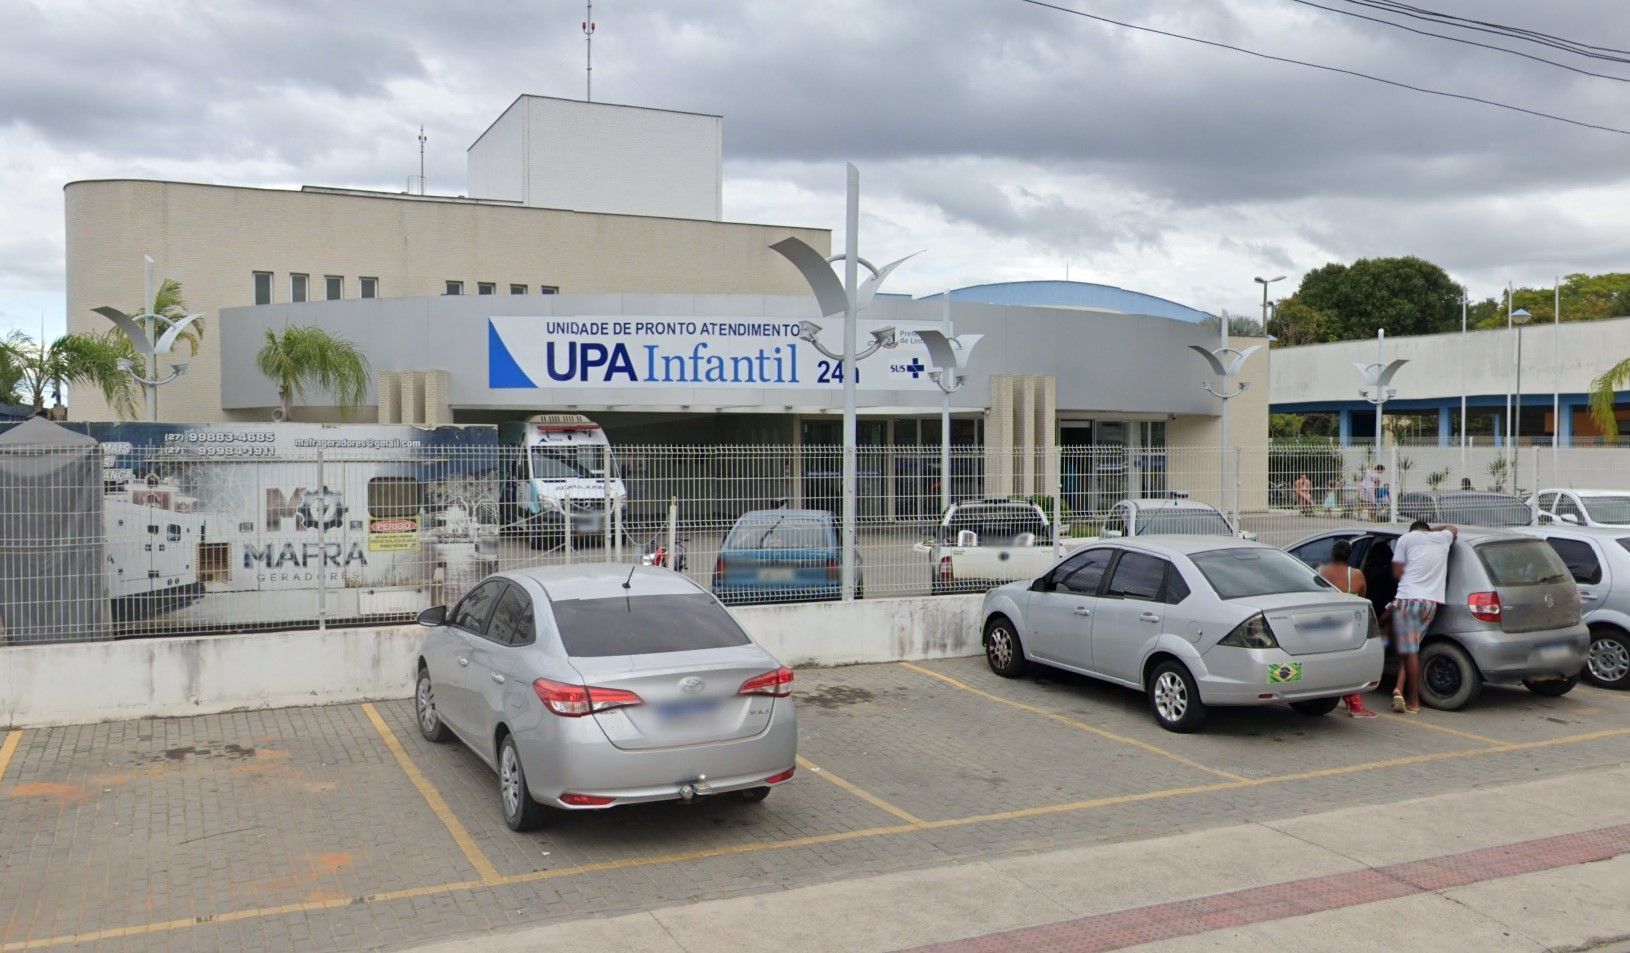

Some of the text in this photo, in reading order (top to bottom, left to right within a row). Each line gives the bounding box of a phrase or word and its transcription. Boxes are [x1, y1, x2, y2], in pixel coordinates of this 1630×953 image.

[546, 321, 800, 337] UNIDADE DE PRONTO ATENDIMENTO
[546, 341, 638, 382] UPA
[643, 342, 800, 383] Infantil
[890, 364, 906, 373] SUS
[164, 432, 276, 443] (27) 99883-4685
[377, 522, 411, 530] PERIGO
[243, 542, 368, 569] MAFRA
